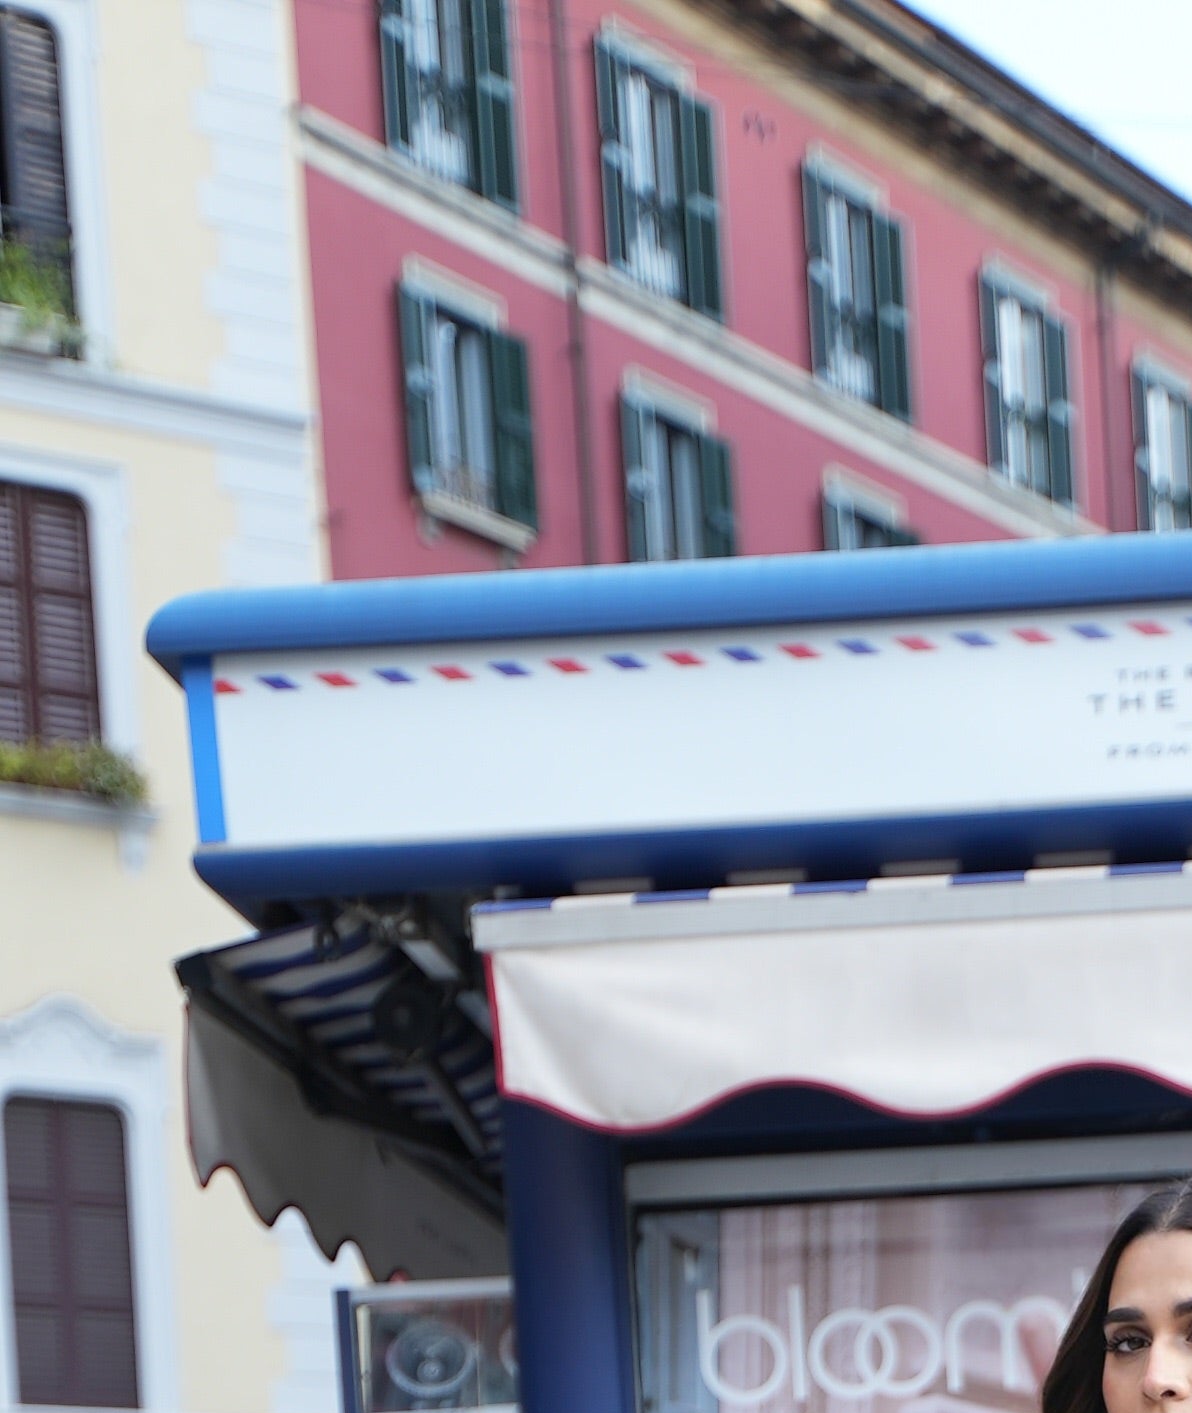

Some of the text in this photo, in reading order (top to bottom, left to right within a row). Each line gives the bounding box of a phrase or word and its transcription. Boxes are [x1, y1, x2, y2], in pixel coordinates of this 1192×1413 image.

[1116, 665, 1171, 682] THE
[1088, 689, 1176, 714] THE
[1106, 742, 1189, 760] FROM
